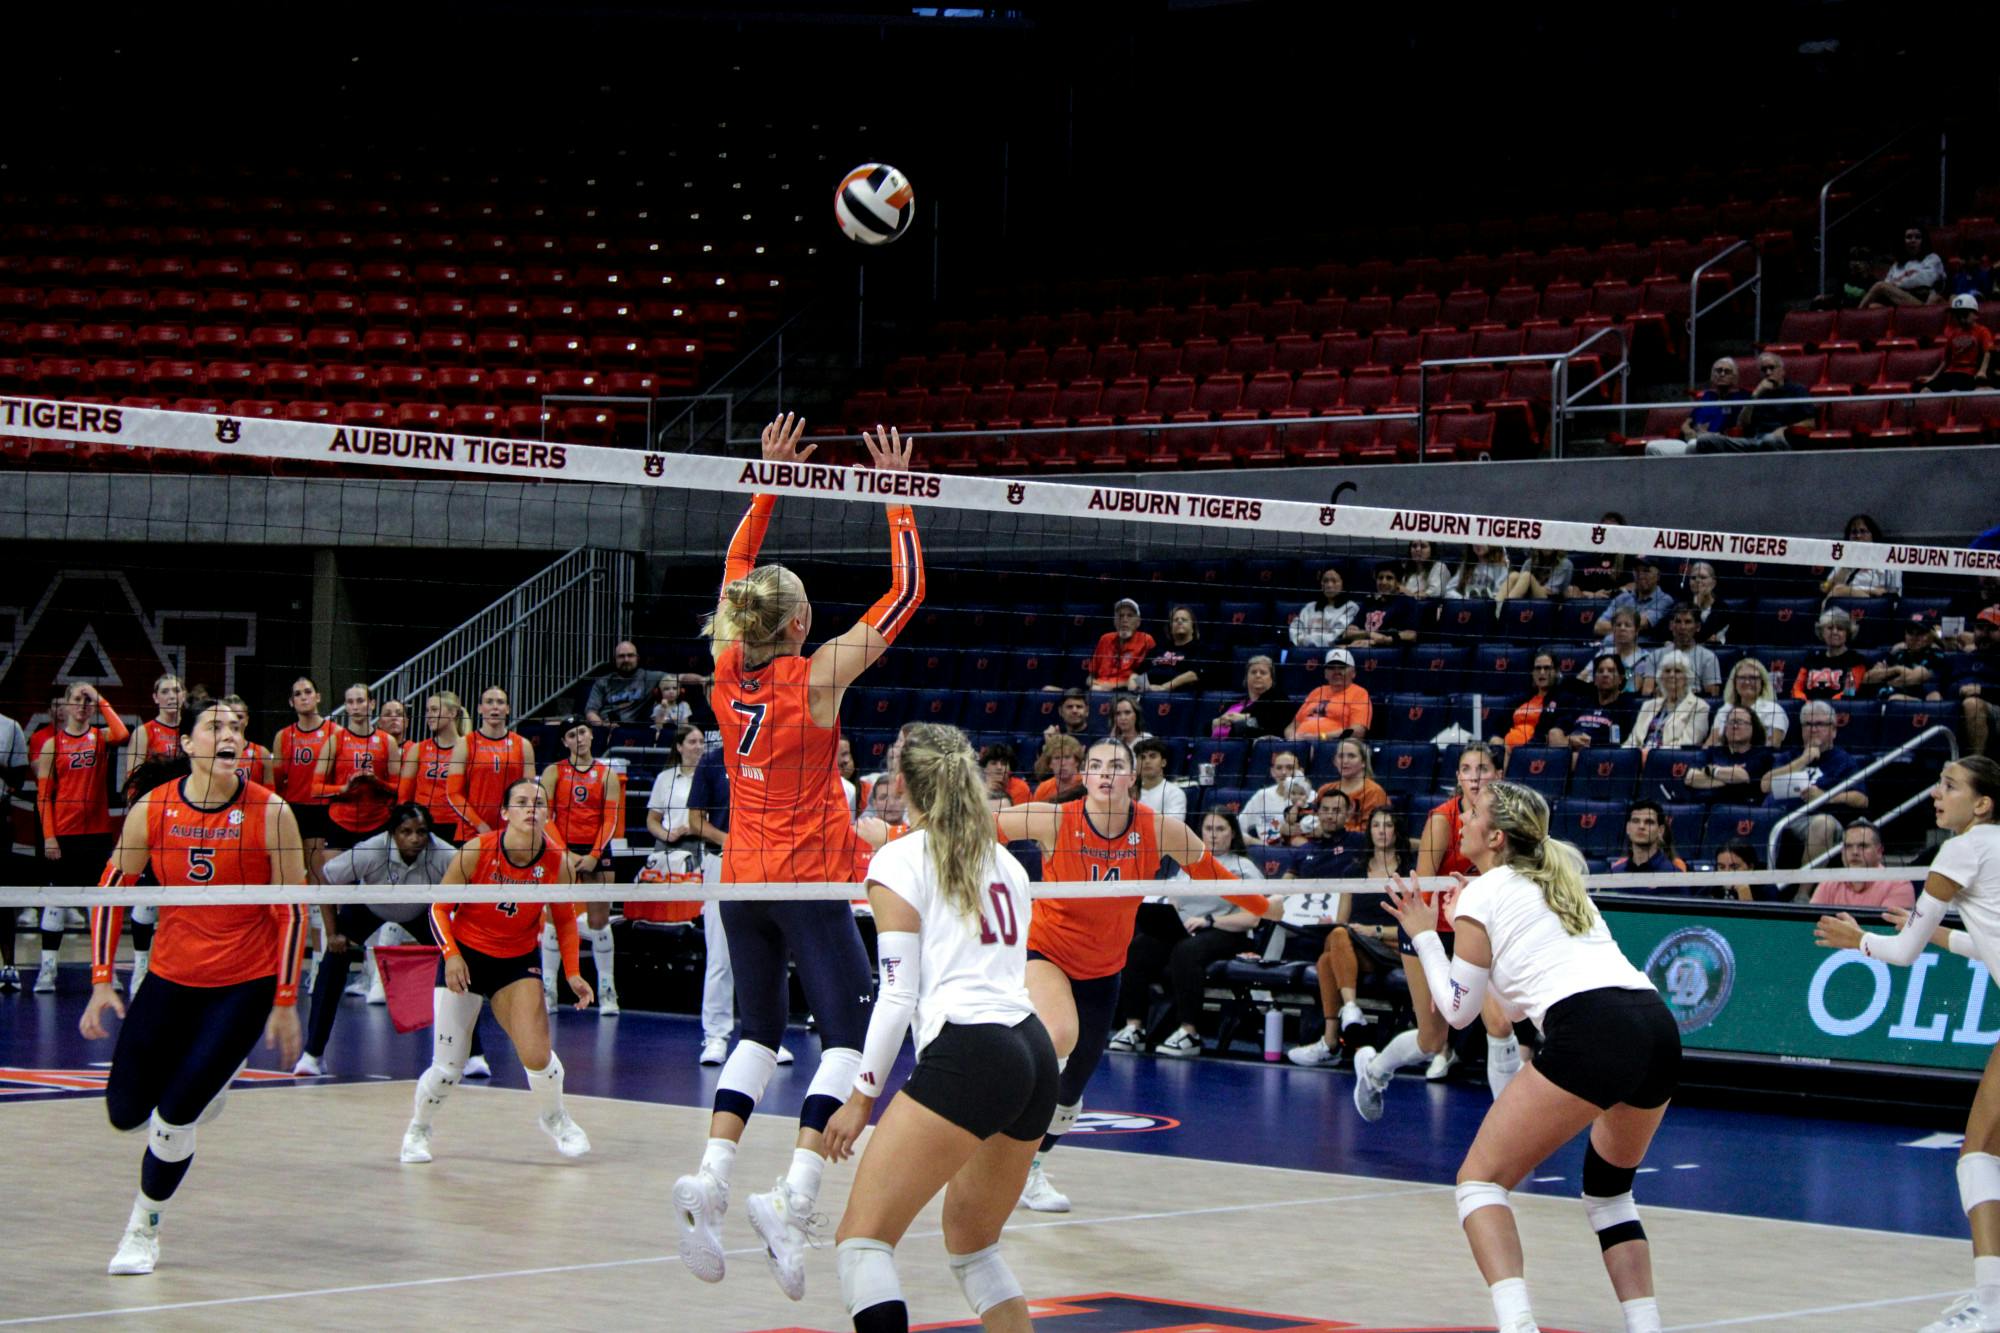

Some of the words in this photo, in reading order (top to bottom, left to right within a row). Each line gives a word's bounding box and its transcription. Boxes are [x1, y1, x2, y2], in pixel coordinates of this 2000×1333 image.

[0, 399, 123, 434] TIGERS
[329, 428, 454, 461] AUBURN
[463, 439, 567, 469] TIGERS
[739, 462, 846, 490] AUBURN
[853, 471, 941, 498] TIGERS
[1088, 489, 1180, 515] AUBURN
[1187, 496, 1263, 521] TIGERS
[1390, 512, 1470, 535] AUBURN
[1476, 517, 1542, 540] TIGERS
[1654, 531, 1724, 552] AUBURN
[1730, 536, 1788, 556] TIGERS
[1886, 547, 1949, 567] AUBURN
[731, 699, 767, 756] 7
[70, 749, 97, 770] 25
[294, 747, 313, 766] 10
[354, 751, 372, 769] 12
[493, 754, 501, 773] 1
[427, 761, 449, 779] 22
[573, 784, 588, 803] 9
[168, 824, 241, 841] AUBURN
[1081, 845, 1138, 860] AUBURN
[186, 846, 216, 883] 5
[1090, 863, 1121, 882] 14
[495, 902, 518, 918] 4
[980, 882, 1018, 946] 10
